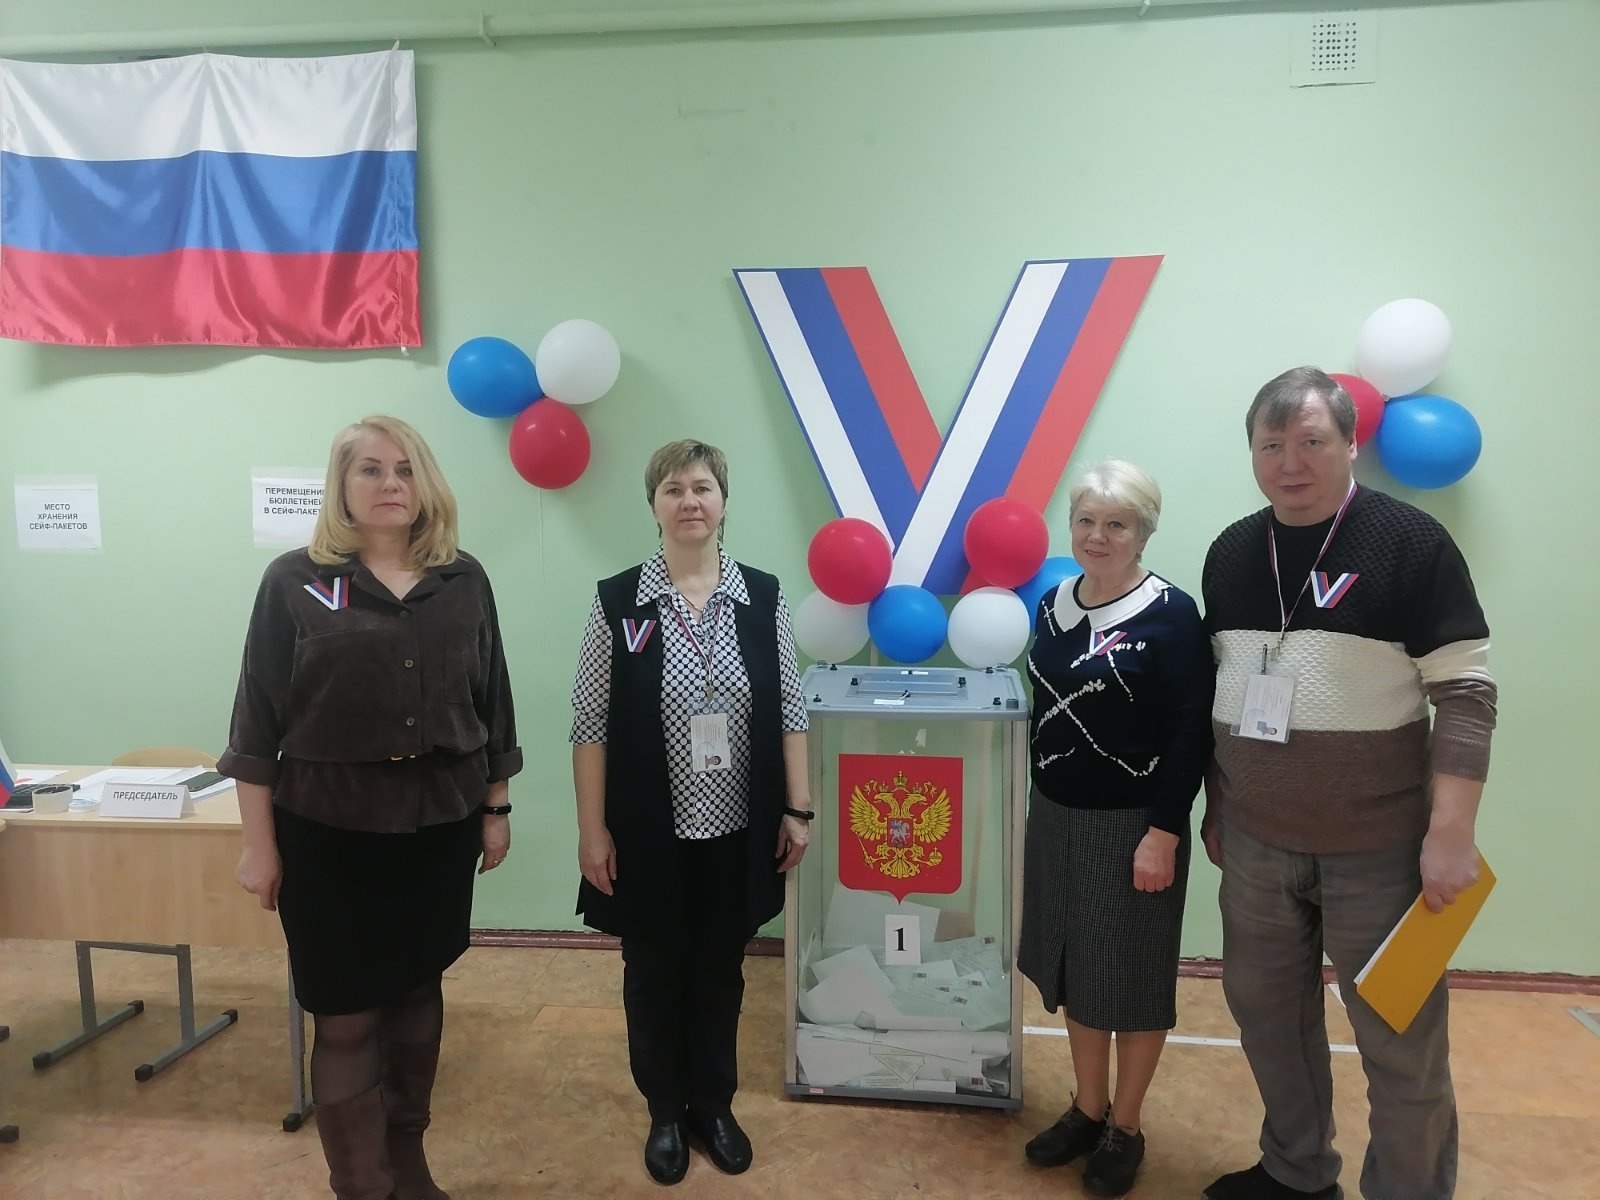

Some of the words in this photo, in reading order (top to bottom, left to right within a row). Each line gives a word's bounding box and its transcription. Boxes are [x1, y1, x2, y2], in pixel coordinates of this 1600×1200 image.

[44, 503, 71, 511] МЕСТО
[271, 506, 321, 515] СЕЙФ-ПАКЕТ
[29, 522, 88, 530] СЕЙФ-ПАКЕТОВ
[113, 791, 178, 801] ПРЕДСЕДАТЕЛЬ
[892, 927, 908, 952] 1
